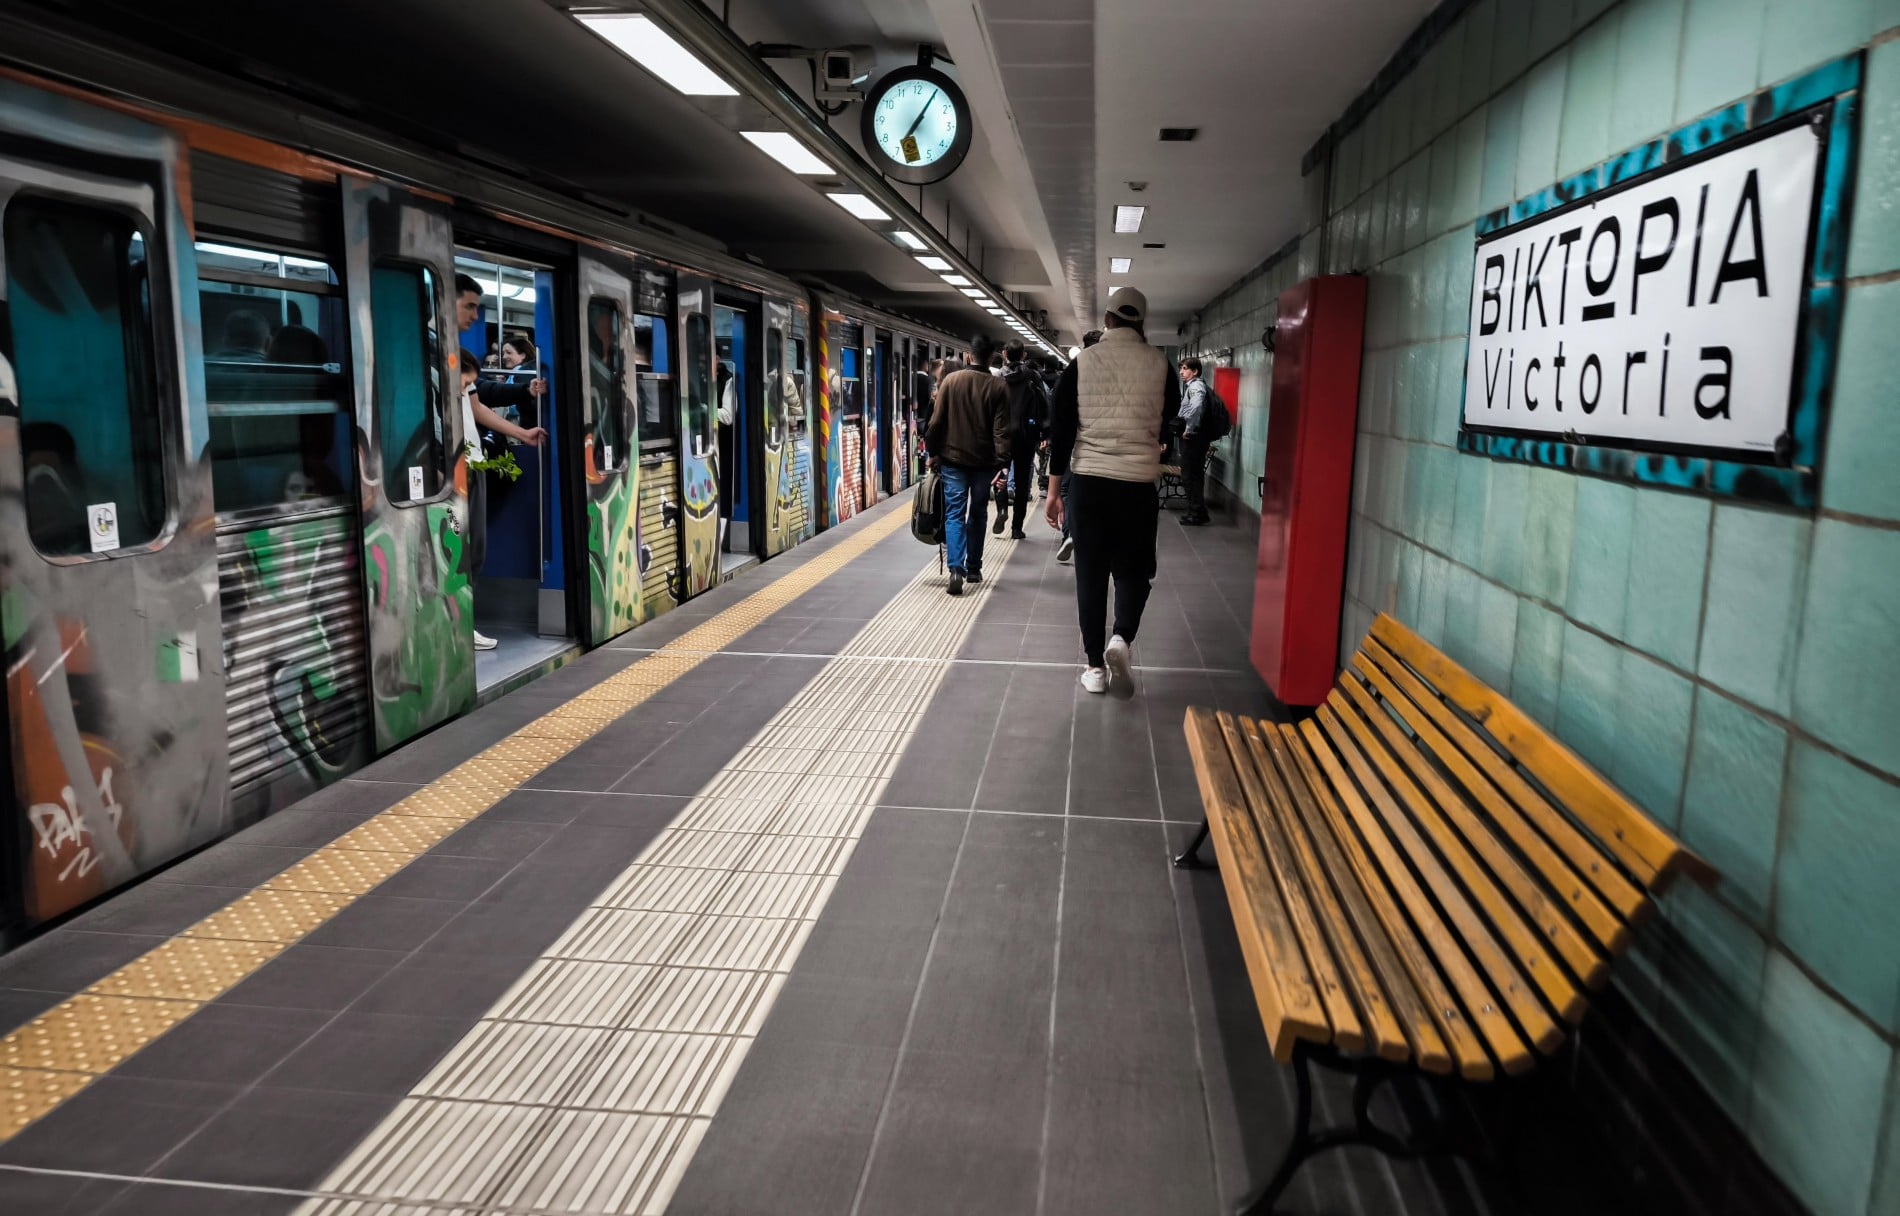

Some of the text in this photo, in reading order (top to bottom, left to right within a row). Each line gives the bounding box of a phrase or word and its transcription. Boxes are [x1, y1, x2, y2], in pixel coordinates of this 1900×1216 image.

[897, 88, 905, 97] 11
[913, 84, 922, 95] 12
[885, 99, 894, 110] 10
[943, 104, 949, 114] 2
[879, 115, 885, 125] 9
[946, 121, 951, 131] 3
[882, 133, 889, 143] 8
[938, 139, 945, 148] 4
[895, 146, 900, 156] 7
[926, 149, 932, 159] 5
[1479, 168, 1769, 336] ΒΙΚΤΟΡΙΑ
[1483, 332, 1735, 421] Victoria
